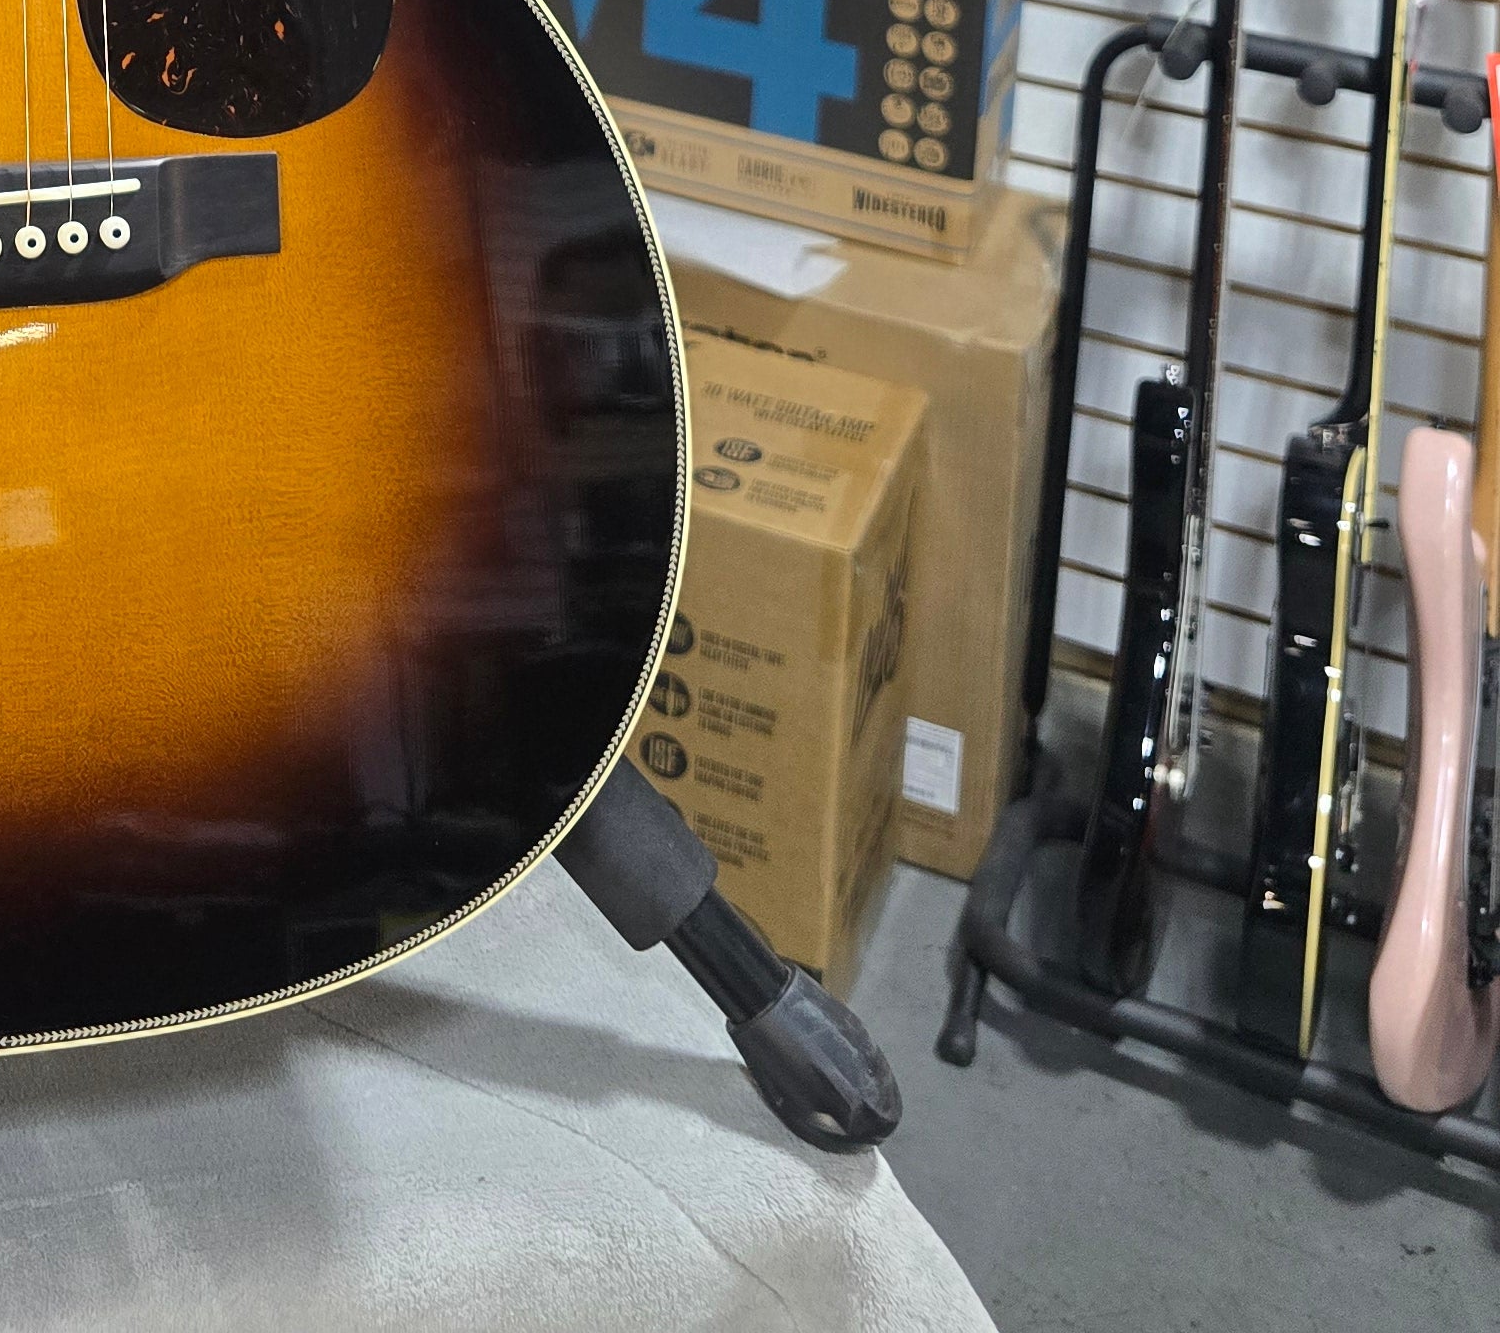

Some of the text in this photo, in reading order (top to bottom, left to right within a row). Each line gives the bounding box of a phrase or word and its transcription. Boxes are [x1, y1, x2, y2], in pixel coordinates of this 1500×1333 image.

[726, 386, 773, 408] WATT
[774, 397, 833, 423] GUITAR
[835, 414, 876, 434] AMP
